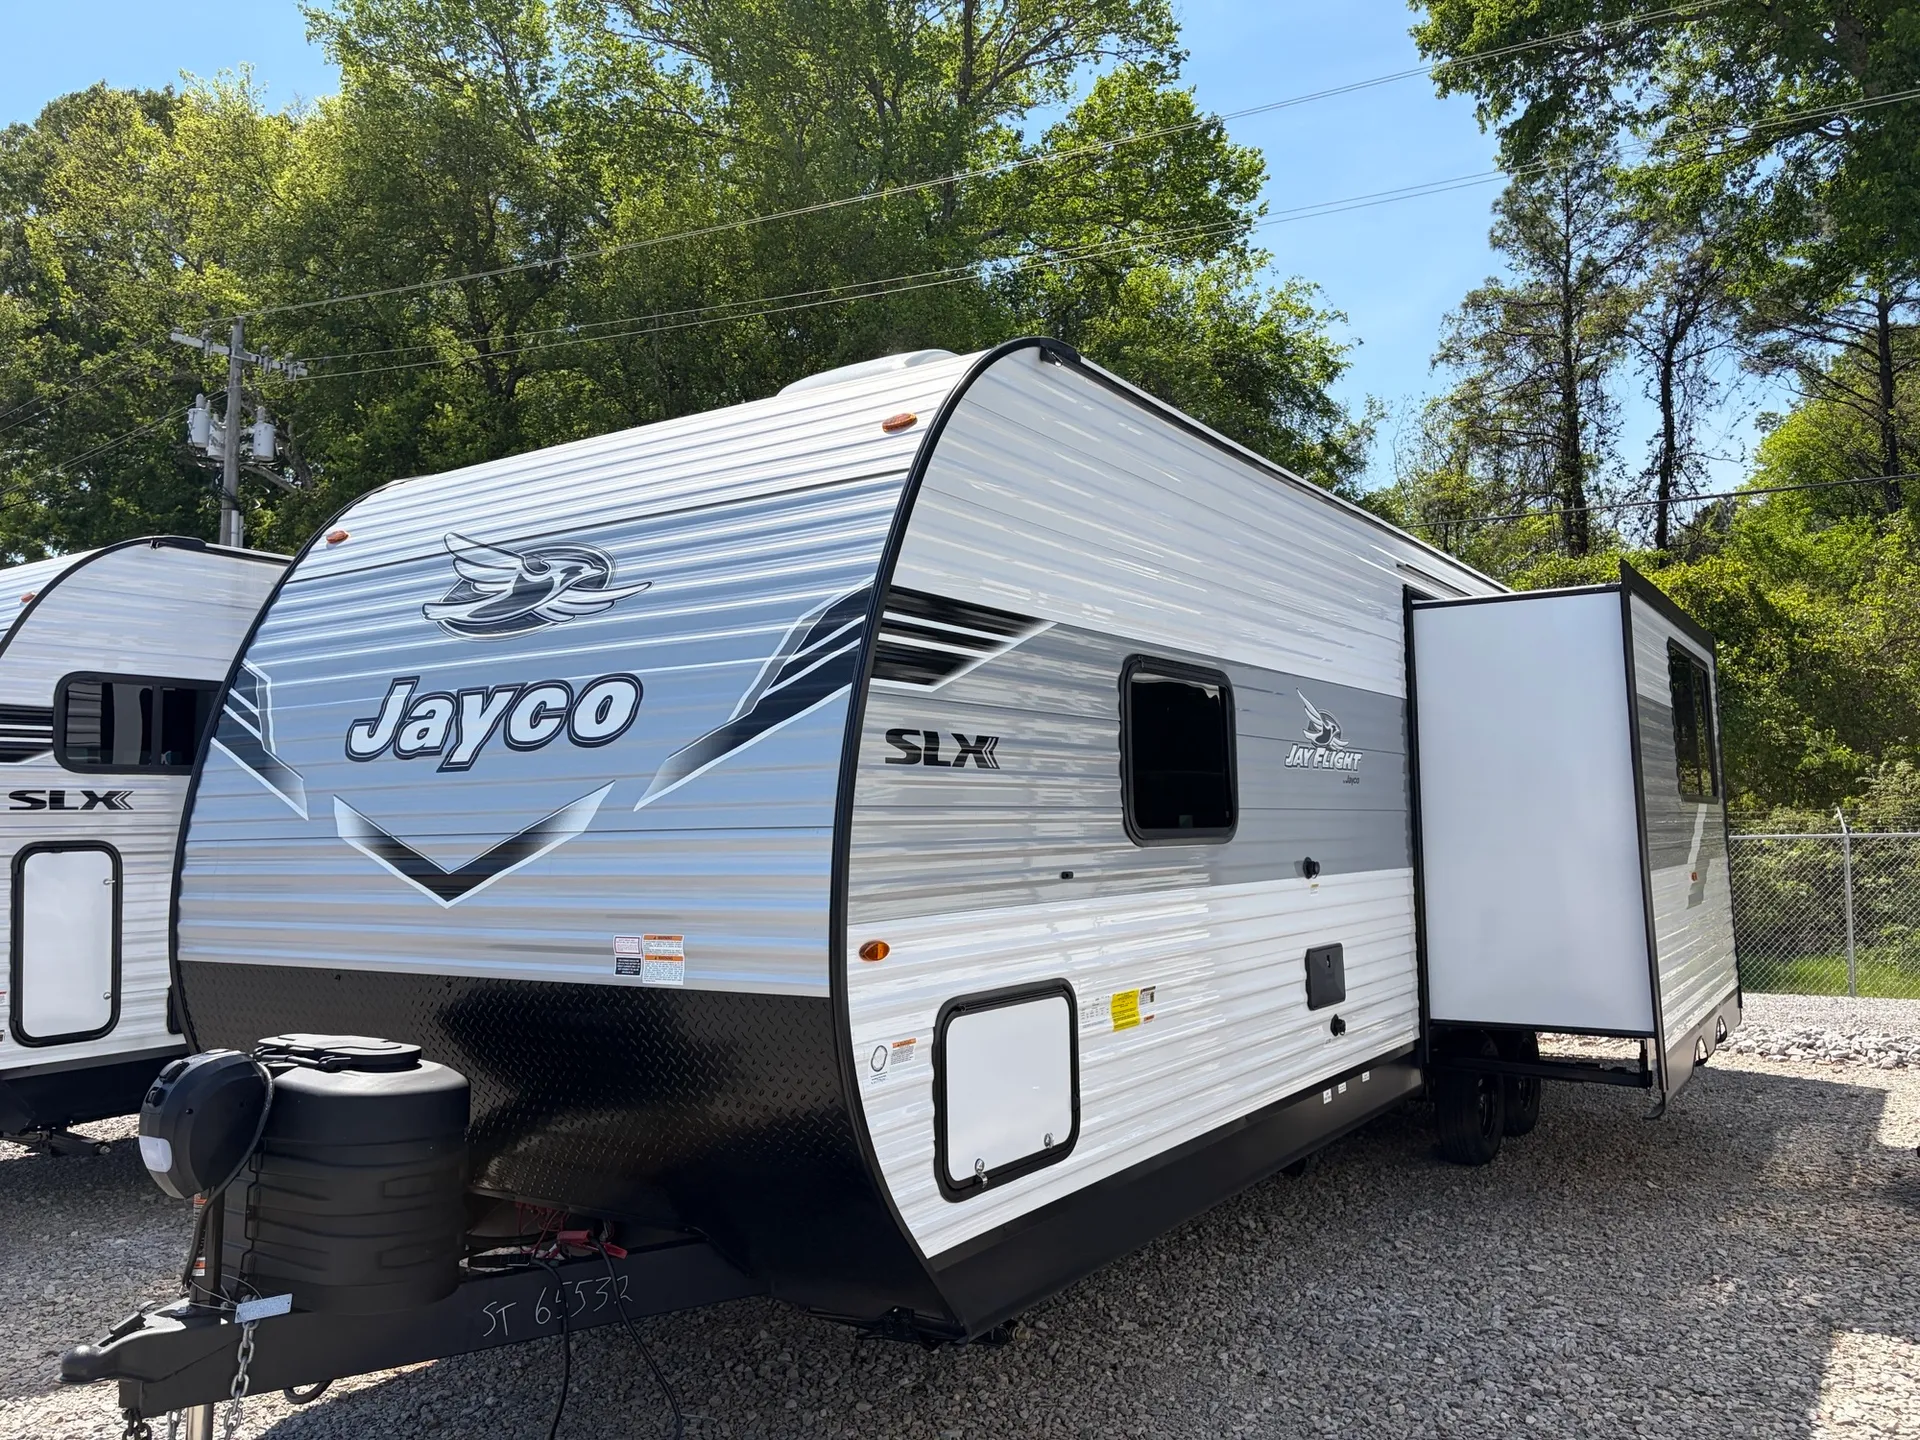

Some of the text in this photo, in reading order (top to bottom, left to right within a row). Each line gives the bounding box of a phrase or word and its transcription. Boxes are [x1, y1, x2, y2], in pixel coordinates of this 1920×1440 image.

[345, 672, 644, 773] Jayco
[885, 728, 1000, 769] SLX
[1284, 743, 1363, 772] JAY FLIGHT
[8, 790, 134, 810] SLX
[482, 1301, 517, 1337] ST
